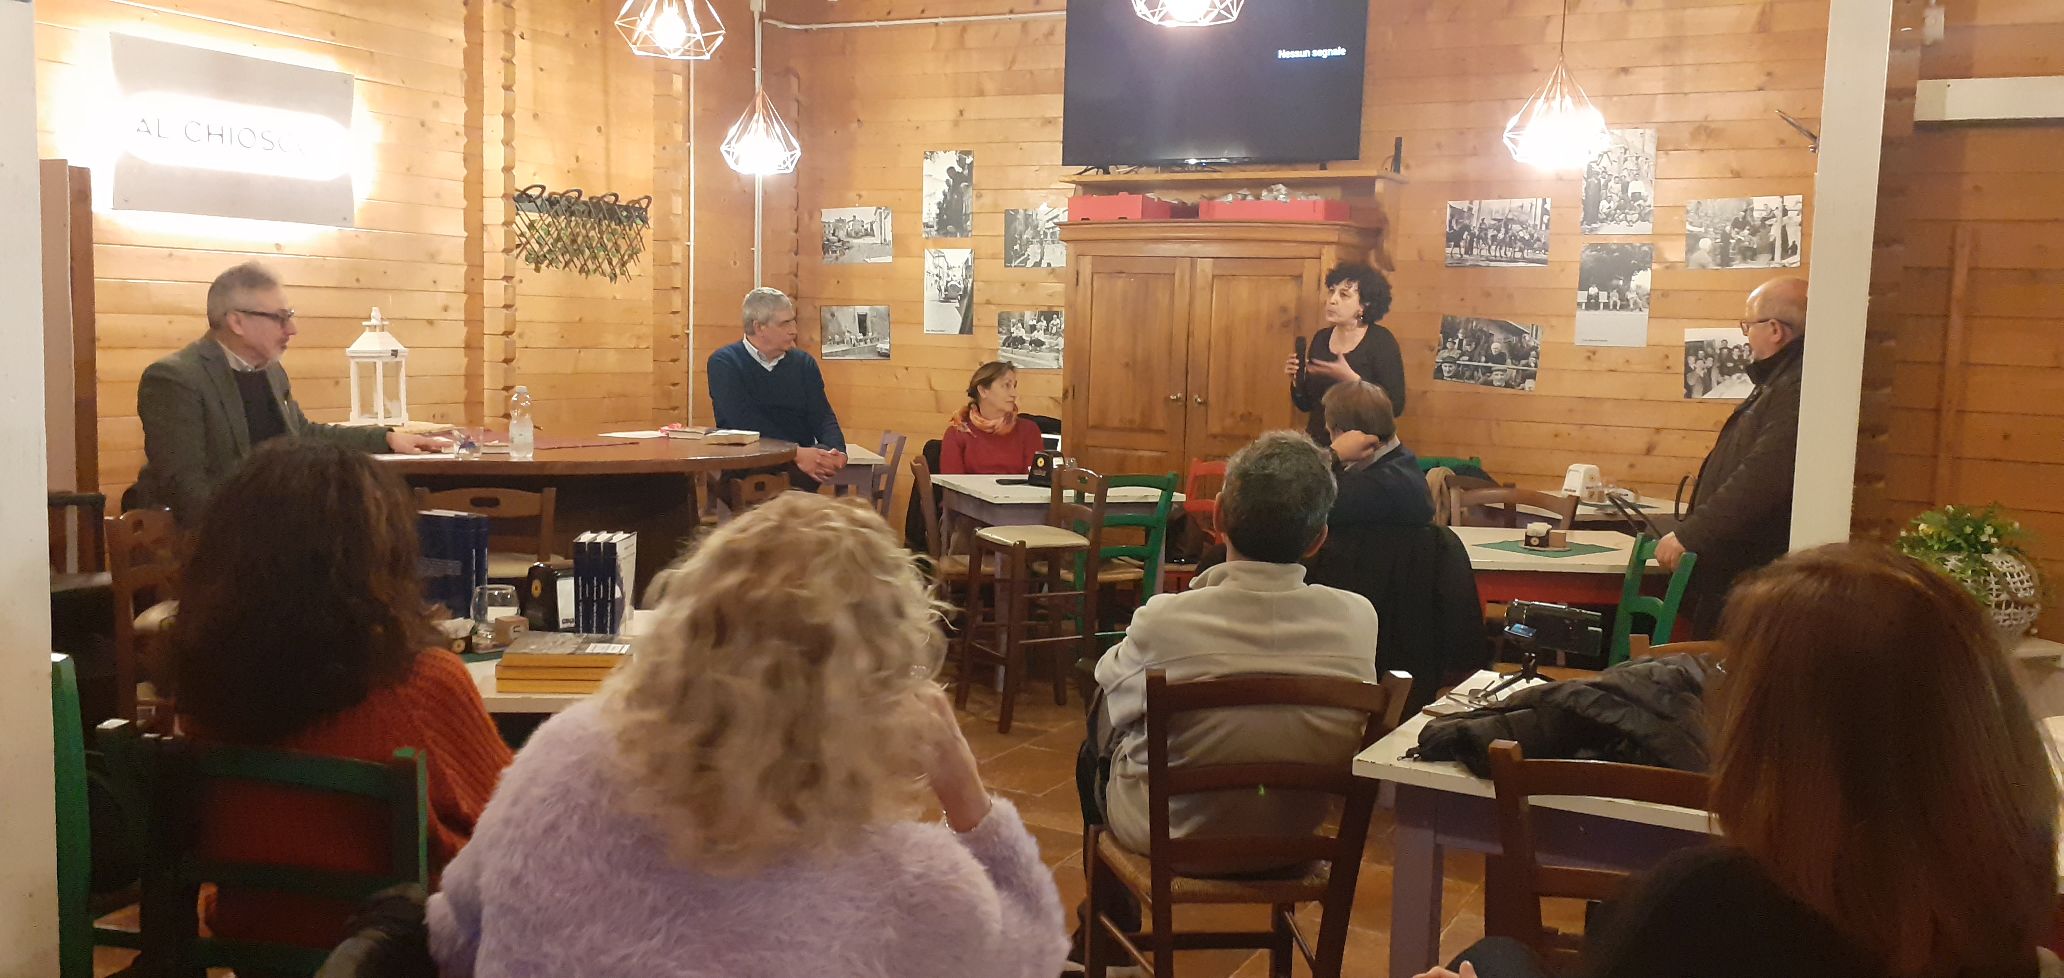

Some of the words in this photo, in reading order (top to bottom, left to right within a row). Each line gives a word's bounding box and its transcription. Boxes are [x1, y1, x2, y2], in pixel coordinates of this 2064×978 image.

[1277, 48, 1311, 59] Nessun
[1311, 45, 1347, 59] segnale
[136, 116, 169, 140] AL
[184, 120, 310, 154] CHIOSC
